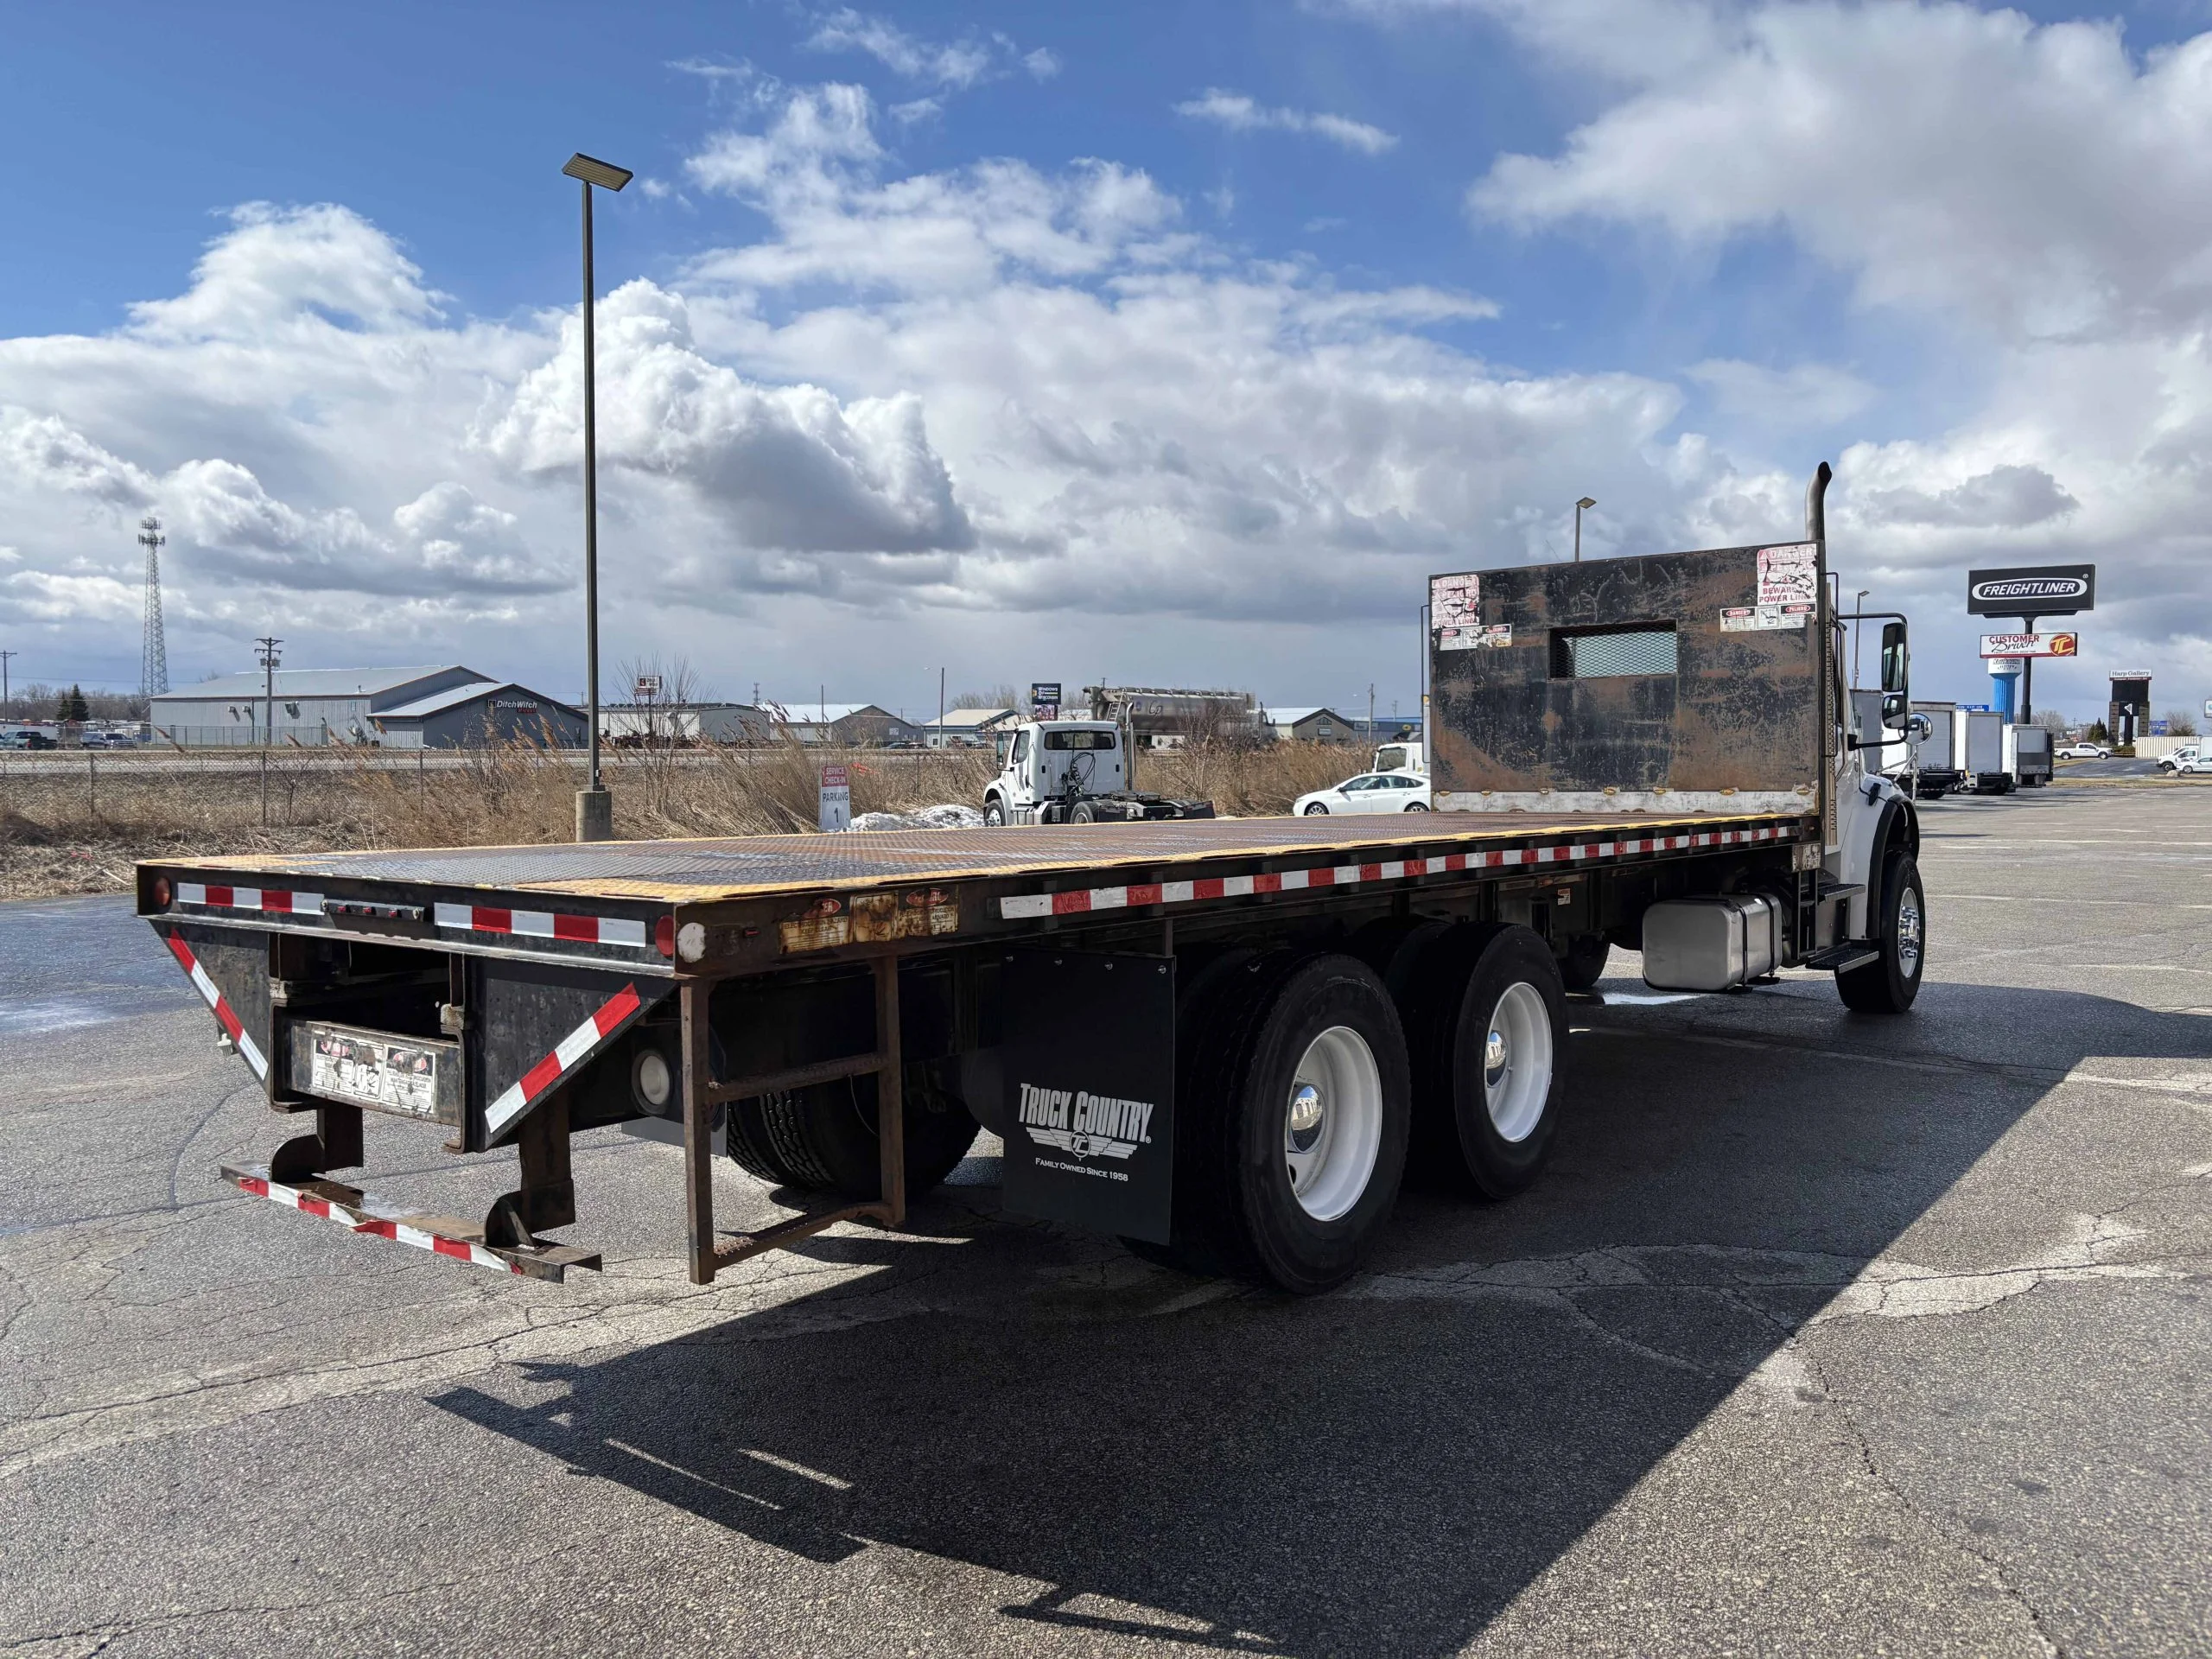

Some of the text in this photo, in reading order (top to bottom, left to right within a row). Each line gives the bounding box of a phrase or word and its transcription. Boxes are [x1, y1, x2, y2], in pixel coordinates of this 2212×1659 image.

[1983, 582, 2075, 595] FREIGHTLINER
[1992, 641, 2034, 652] Driven
[823, 792, 849, 802] PARKING
[834, 807, 839, 823] 1
[1018, 1083, 1154, 1142] TRUCK COUNTRY
[1035, 1158, 1128, 1181] FAMILY OWNED SINCE 1958
